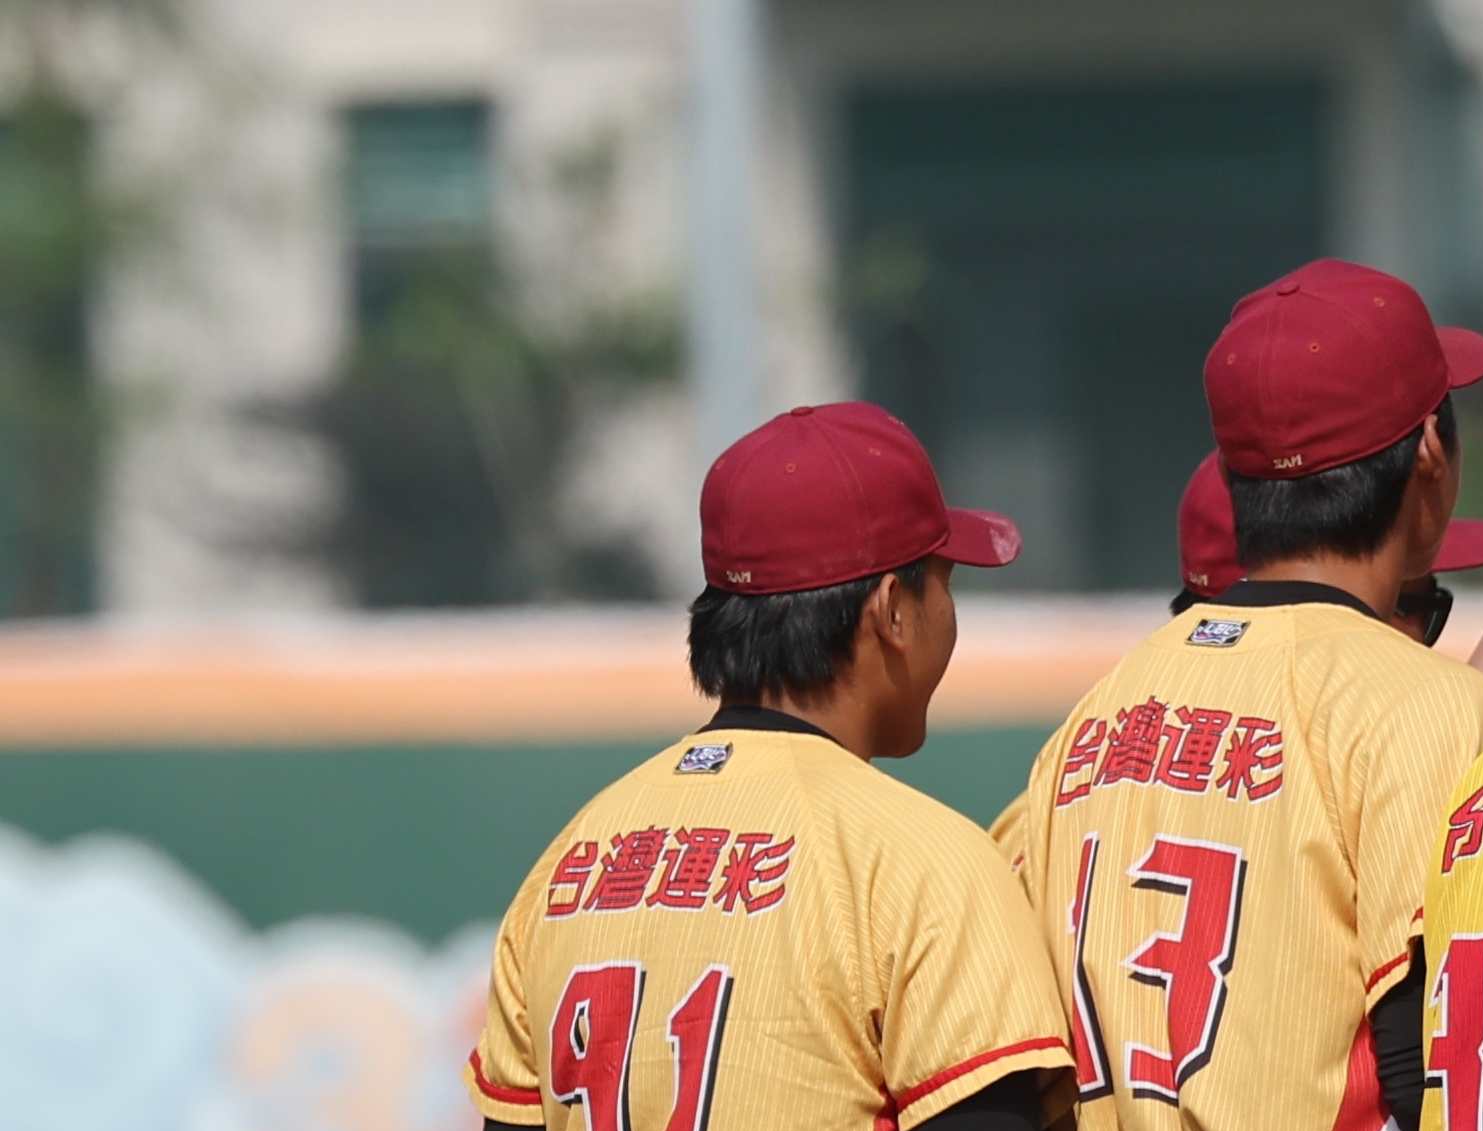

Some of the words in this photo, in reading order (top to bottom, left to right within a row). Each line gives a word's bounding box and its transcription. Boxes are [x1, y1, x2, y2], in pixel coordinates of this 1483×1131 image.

[1055, 695, 1284, 809] 台灣運彩
[543, 825, 796, 920] 台灣運彩
